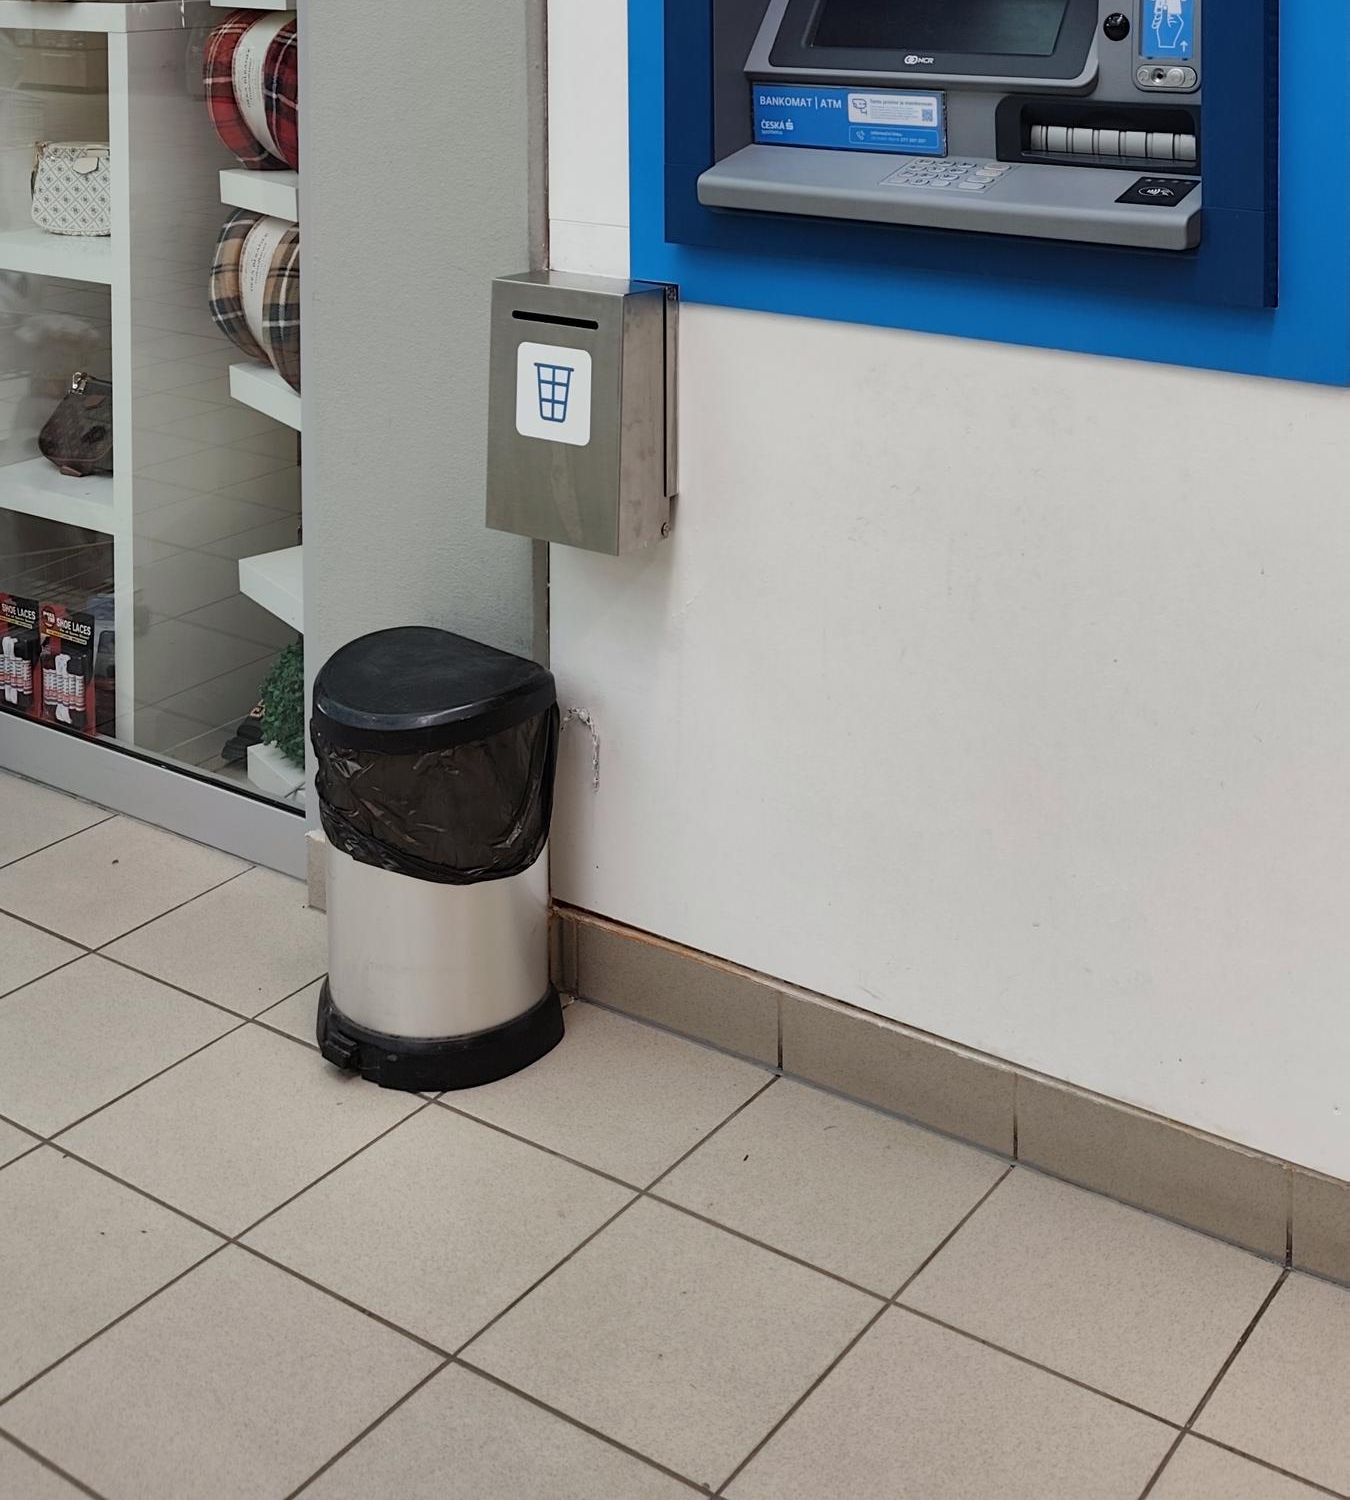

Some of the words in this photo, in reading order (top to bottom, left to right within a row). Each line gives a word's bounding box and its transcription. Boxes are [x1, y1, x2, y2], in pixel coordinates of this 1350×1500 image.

[760, 96, 812, 107] BANKOMAT
[820, 98, 842, 109] ATM
[761, 119, 785, 130] ČESKÁ
[17, 608, 36, 620] LACES
[72, 622, 91, 636] LACES
